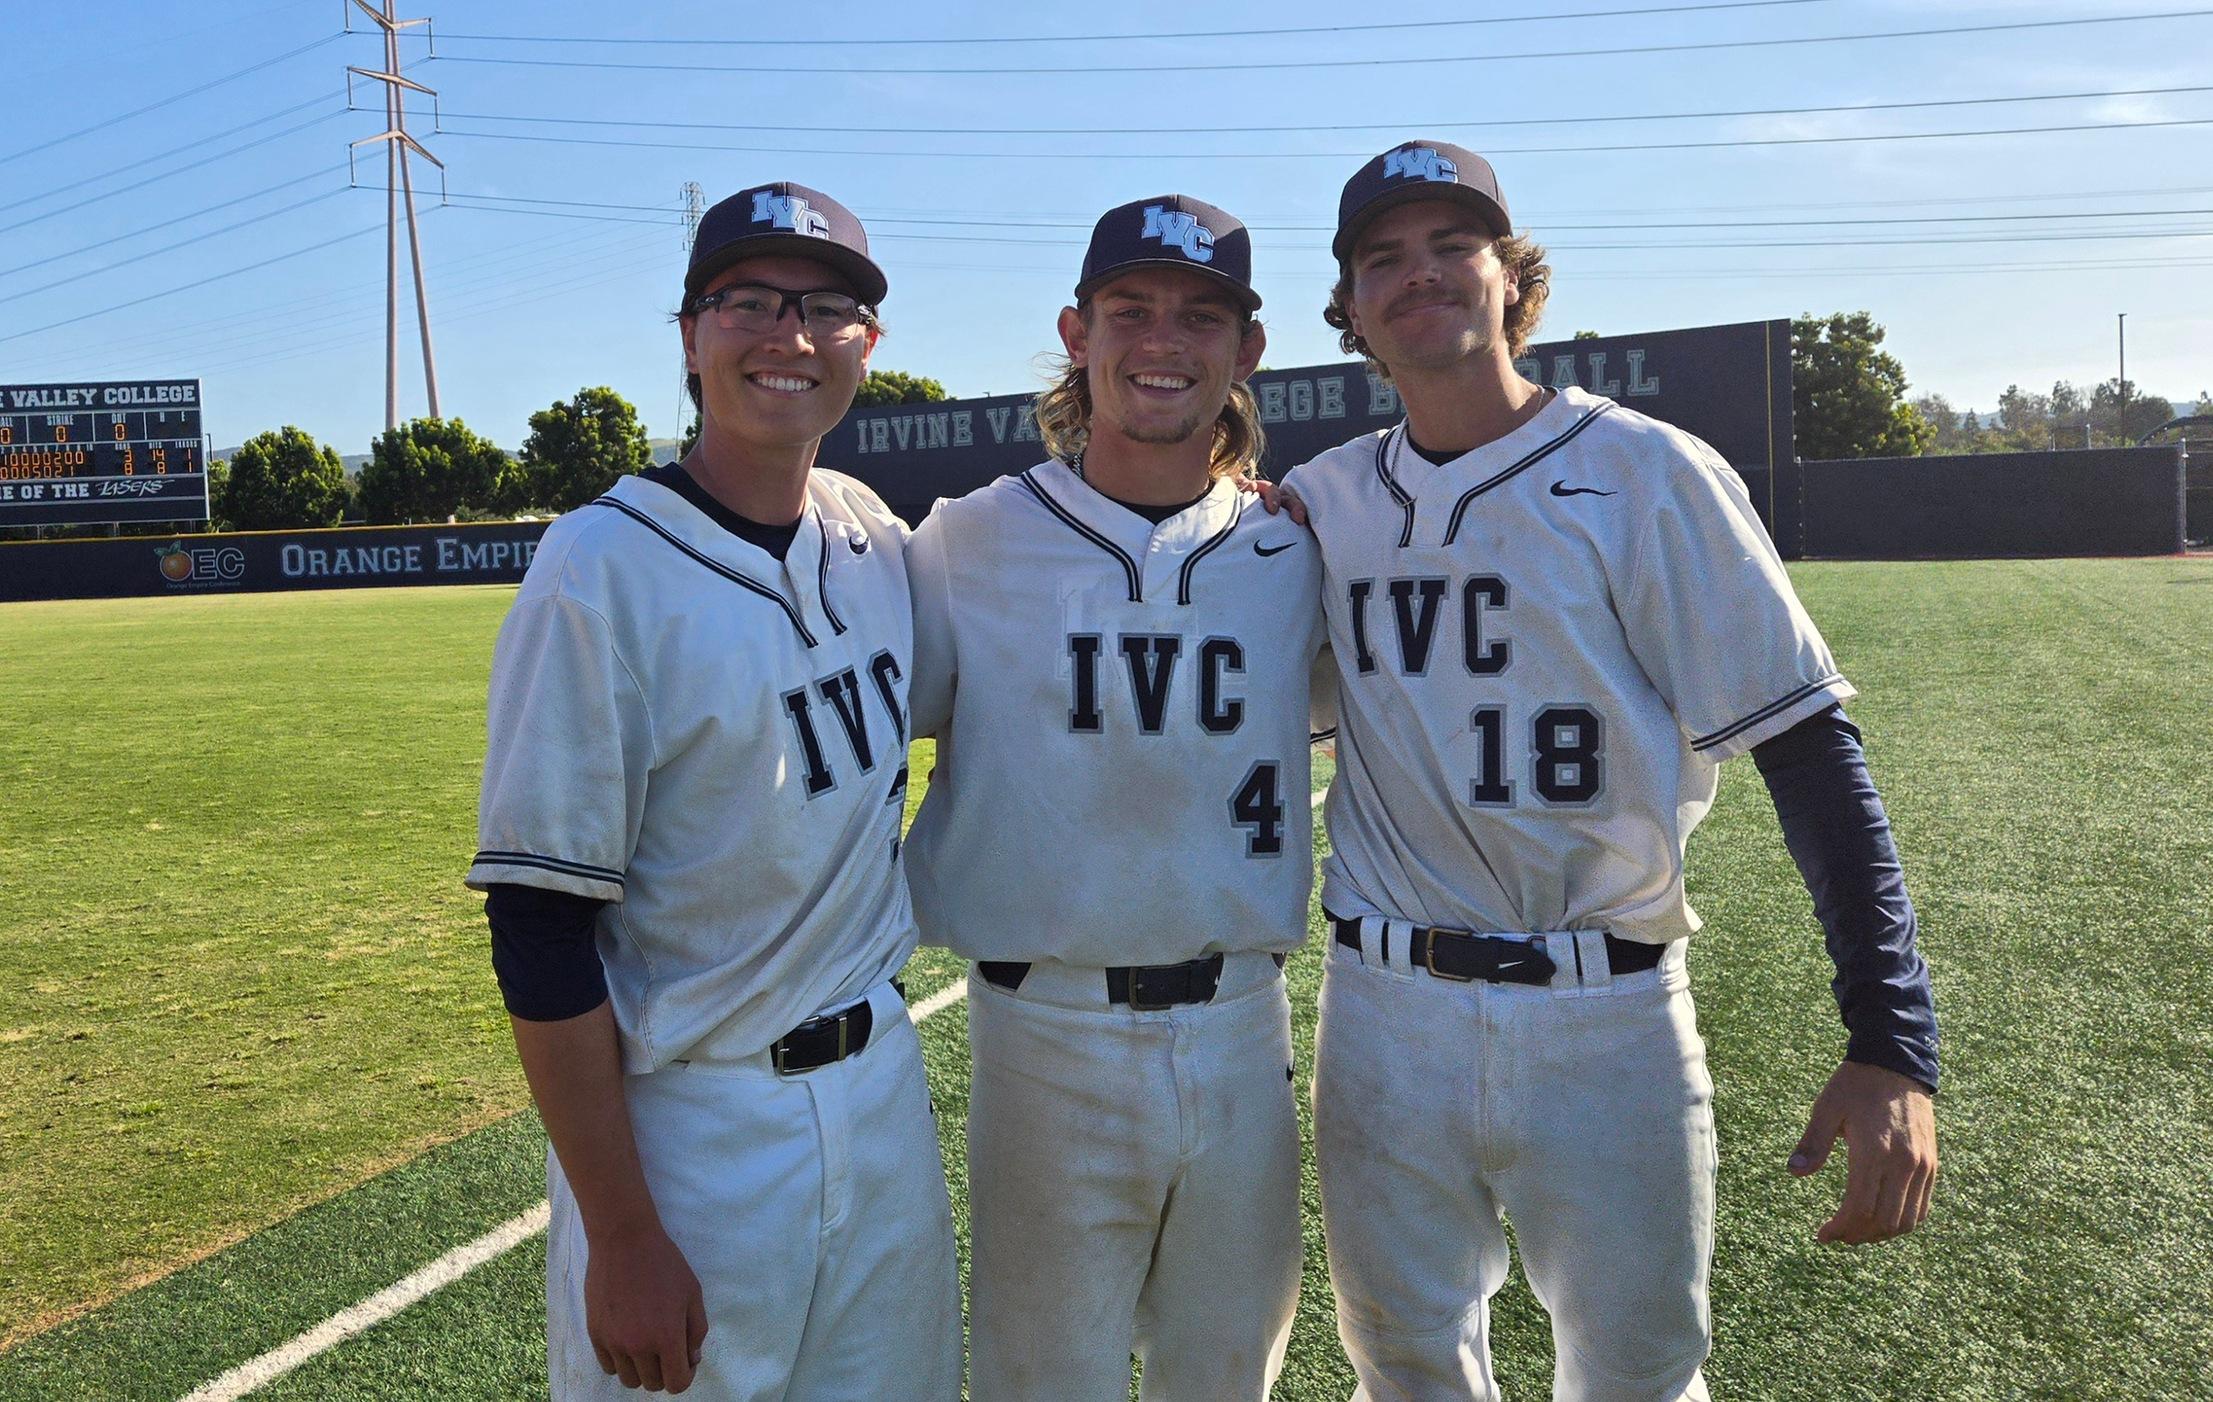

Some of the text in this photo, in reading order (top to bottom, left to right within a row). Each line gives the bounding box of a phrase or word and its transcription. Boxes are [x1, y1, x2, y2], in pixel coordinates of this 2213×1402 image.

[1383, 148, 1458, 184] IVC
[751, 190, 829, 240] IVC
[1142, 205, 1215, 263] IVC
[10, 389, 97, 407] VALLEY
[103, 385, 195, 404] COLLEGE
[0, 416, 13, 427] ALL
[56, 426, 66, 442] 0
[115, 423, 125, 440] 0
[857, 411, 973, 453] IRVINE
[0, 486, 14, 500] E
[21, 485, 44, 499] OF
[51, 483, 89, 498] THE
[1347, 573, 1513, 678] IVC
[1067, 632, 1246, 736] IVC
[1469, 702, 1606, 808] 18
[1226, 759, 1285, 859] 4
